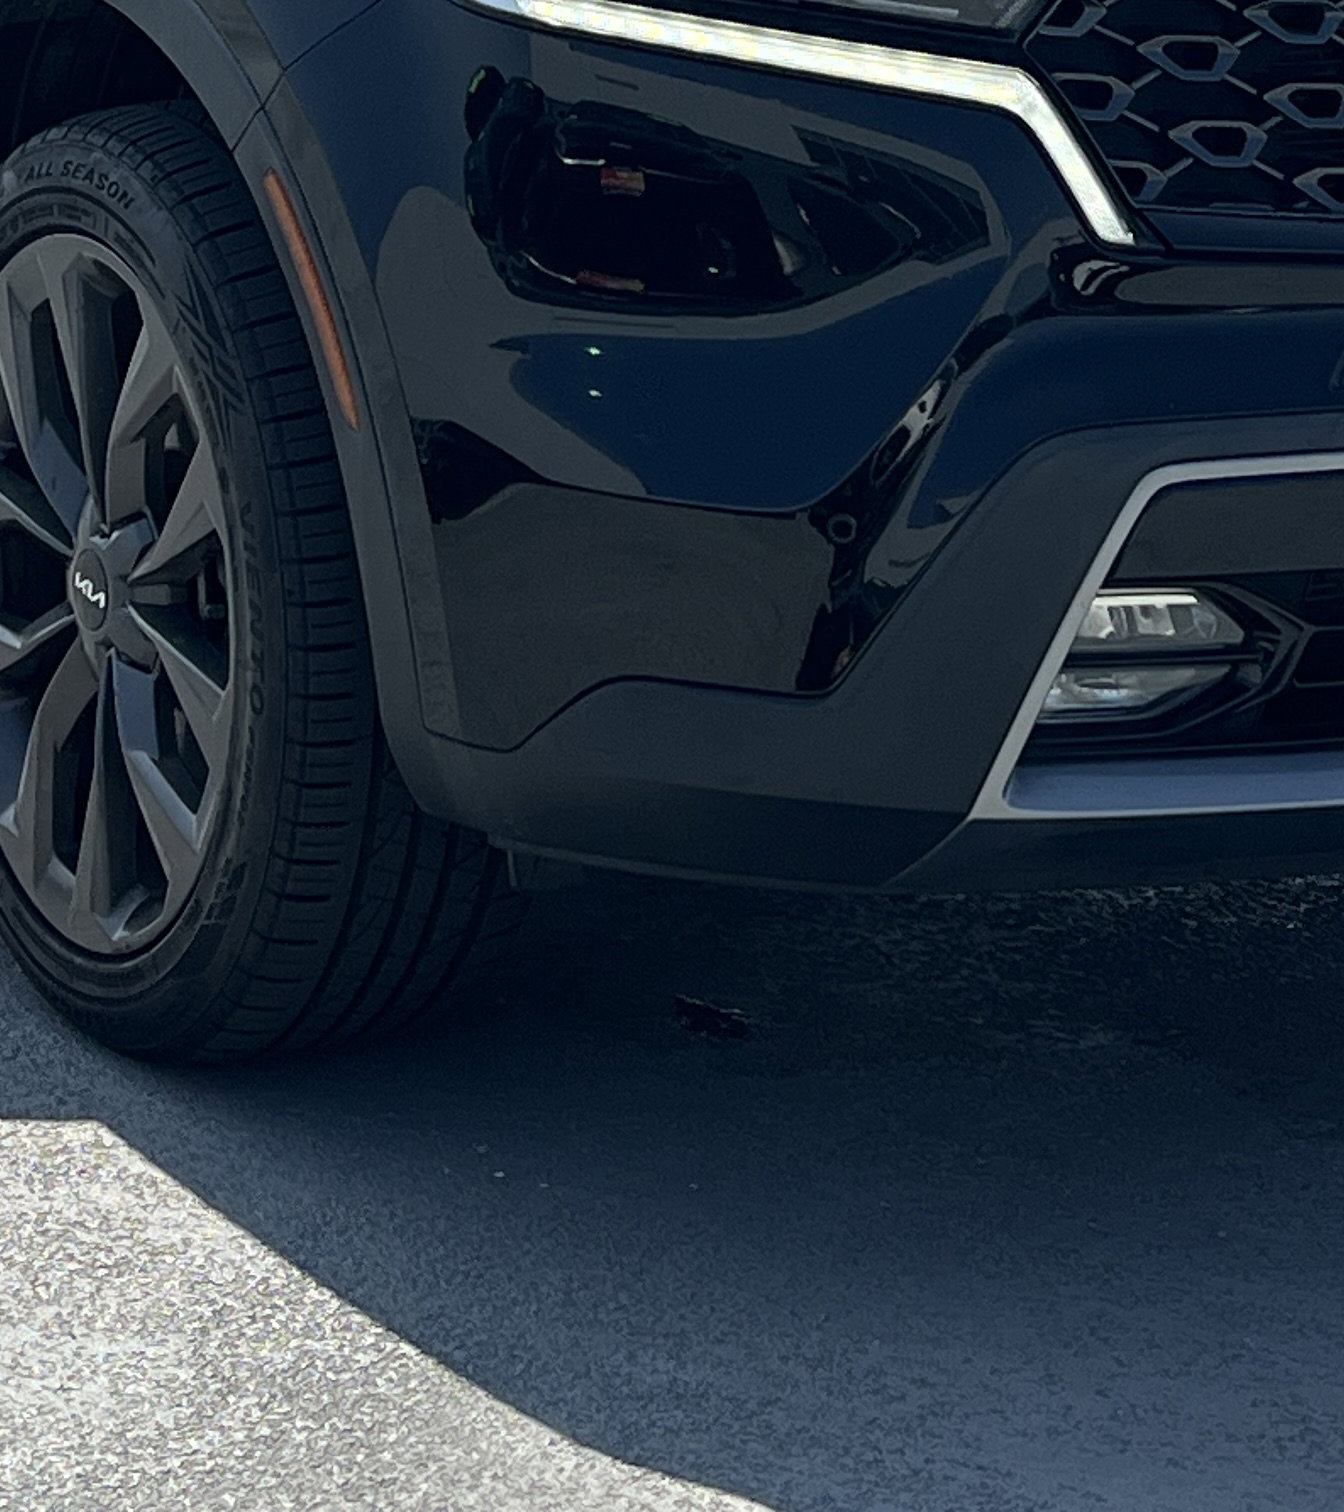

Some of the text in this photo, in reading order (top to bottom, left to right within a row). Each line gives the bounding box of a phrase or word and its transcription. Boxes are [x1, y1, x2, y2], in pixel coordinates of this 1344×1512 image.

[24, 160, 136, 209] ALL SEASON
[75, 572, 105, 608] KIA
